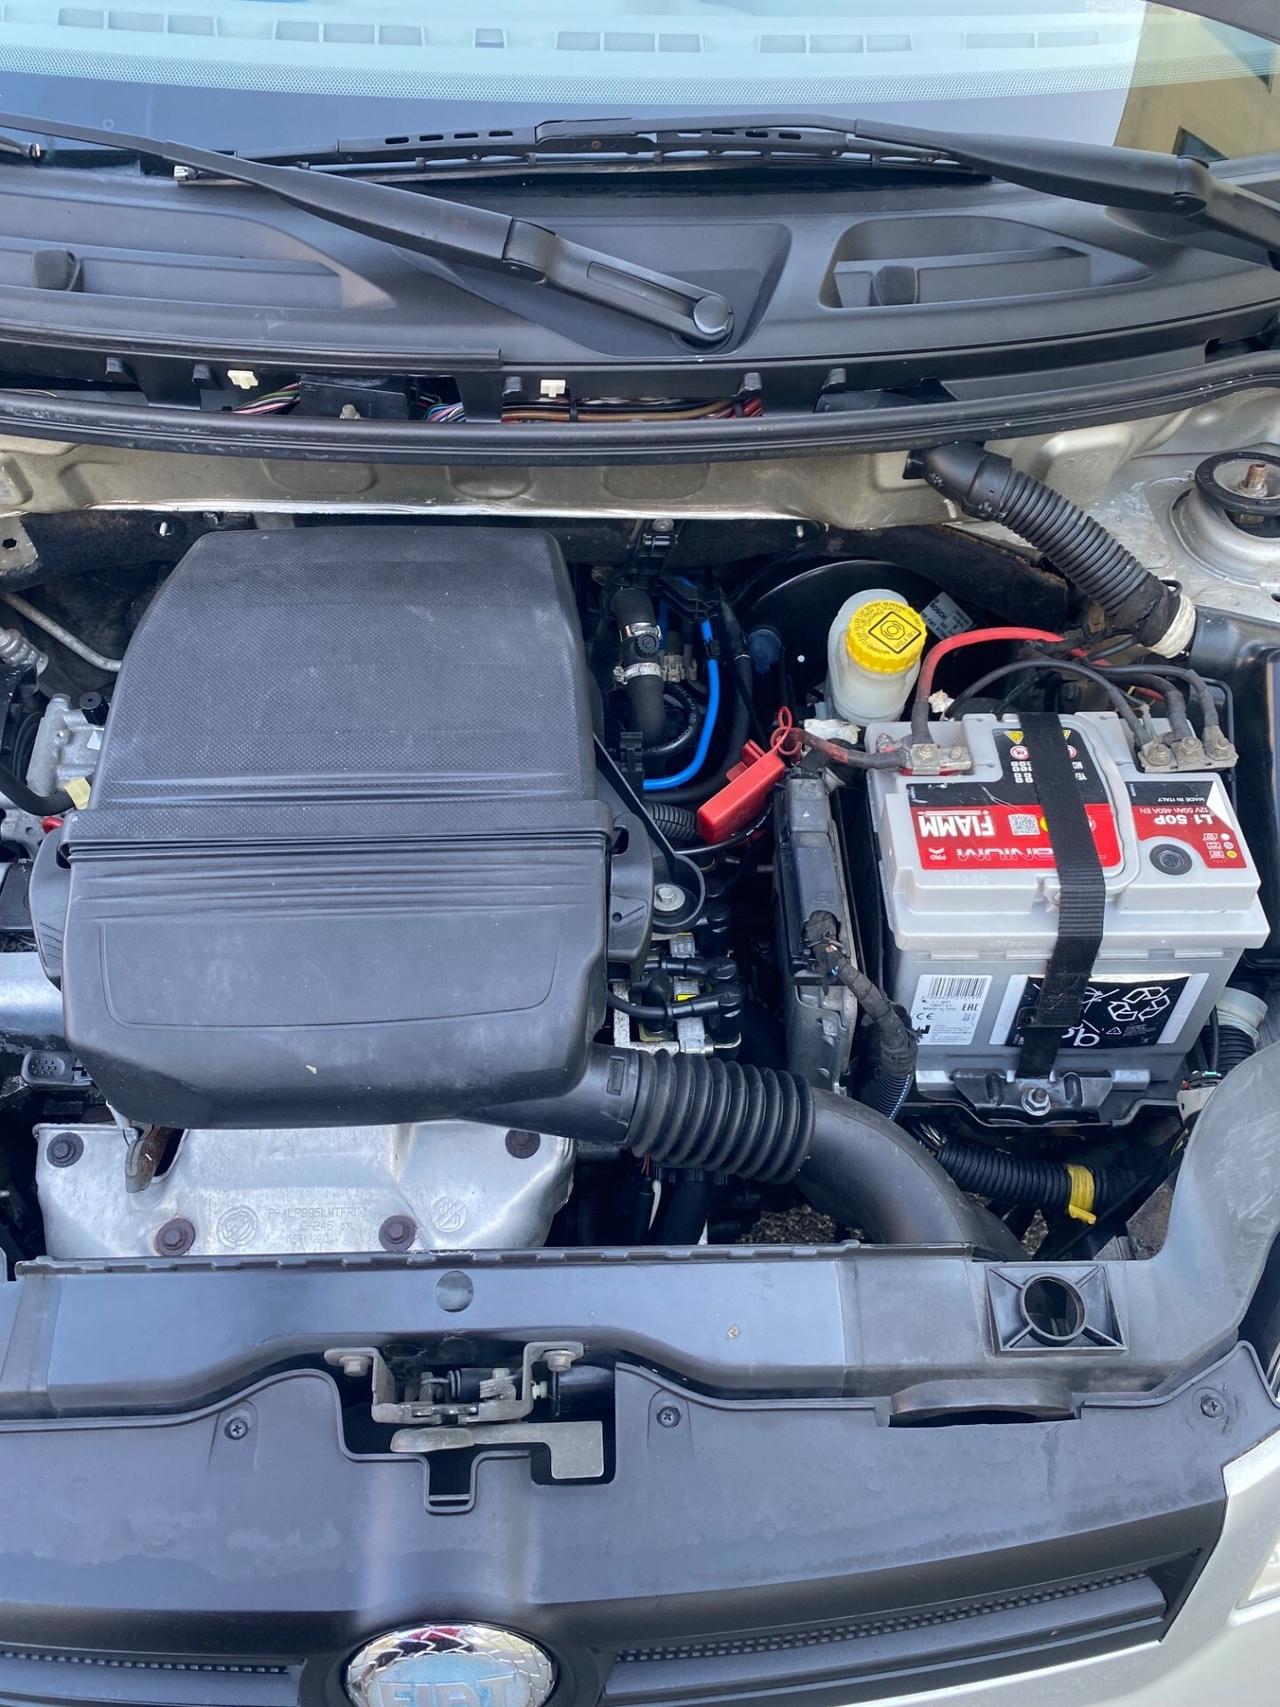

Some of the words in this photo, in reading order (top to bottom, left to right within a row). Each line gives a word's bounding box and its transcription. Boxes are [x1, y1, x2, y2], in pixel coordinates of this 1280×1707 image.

[1153, 814, 1188, 825] 50P
[1192, 813, 1214, 825] L1
[918, 814, 995, 838] FIAMM
[929, 853, 947, 861] PRO
[378, 1673, 516, 1707] FIAT
